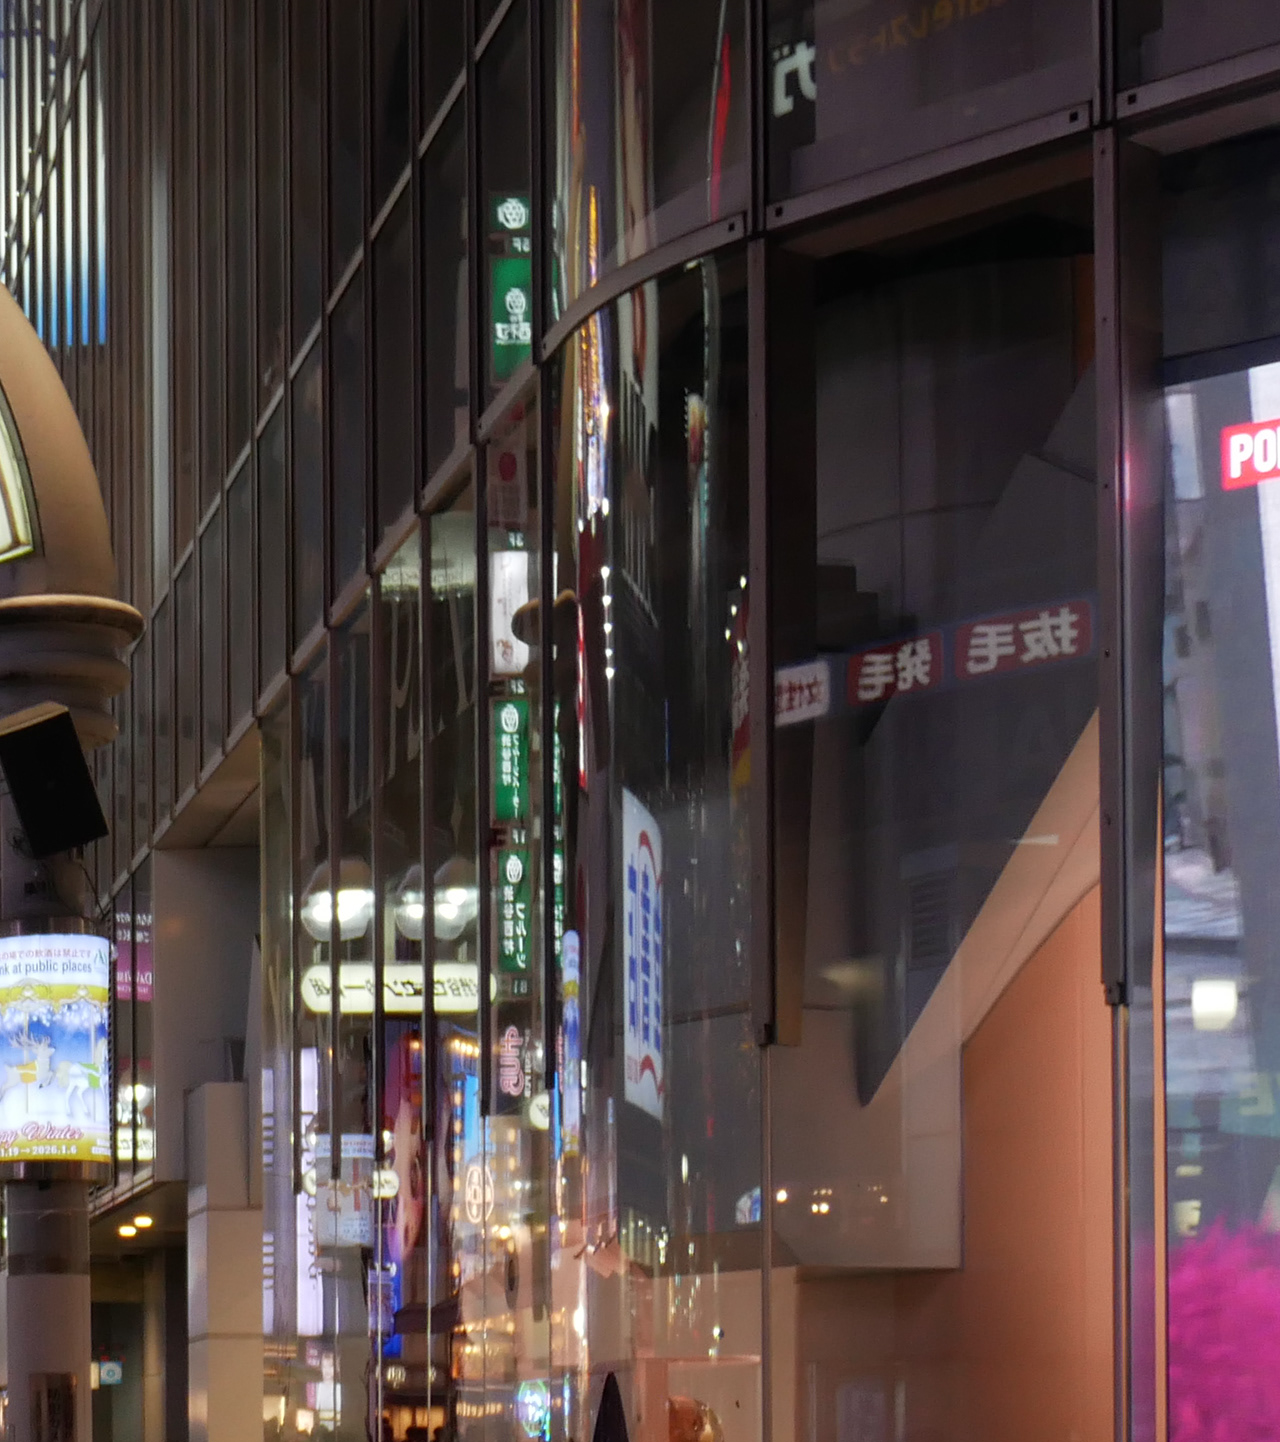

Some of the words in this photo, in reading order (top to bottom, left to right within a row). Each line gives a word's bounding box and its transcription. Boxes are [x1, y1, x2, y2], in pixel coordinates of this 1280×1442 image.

[12, 962, 22, 975] at
[25, 957, 59, 976] public
[61, 958, 93, 976] places
[21, 1120, 85, 1141] Winter
